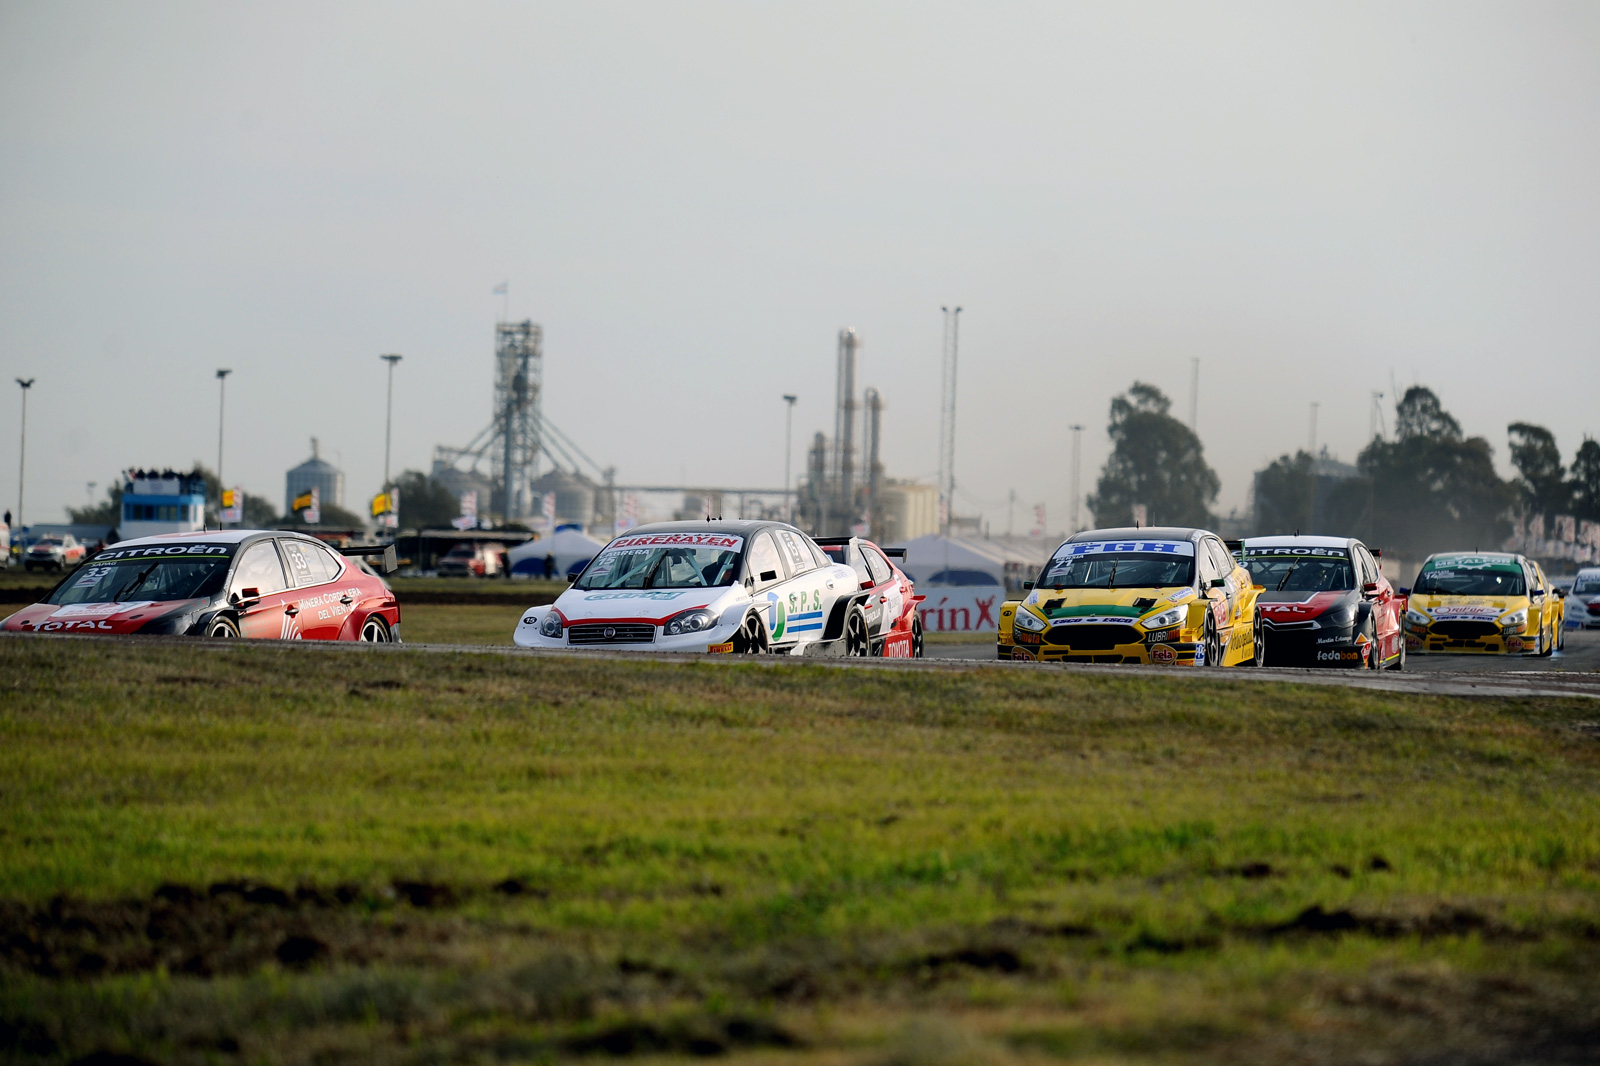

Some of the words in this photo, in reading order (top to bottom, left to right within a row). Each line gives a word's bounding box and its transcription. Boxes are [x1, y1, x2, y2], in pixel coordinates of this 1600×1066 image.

[611, 536, 738, 549] PIRERAYEN
[1068, 544, 1180, 555] FGH
[291, 552, 307, 569] 33
[82, 566, 111, 578] 33
[298, 596, 324, 610] MINERA
[318, 609, 331, 620] DEL
[1261, 606, 1306, 614] TAL
[32, 620, 113, 632] TOTAL
[888, 639, 910, 657] TOYOTA
[1152, 648, 1173, 660] Fela
